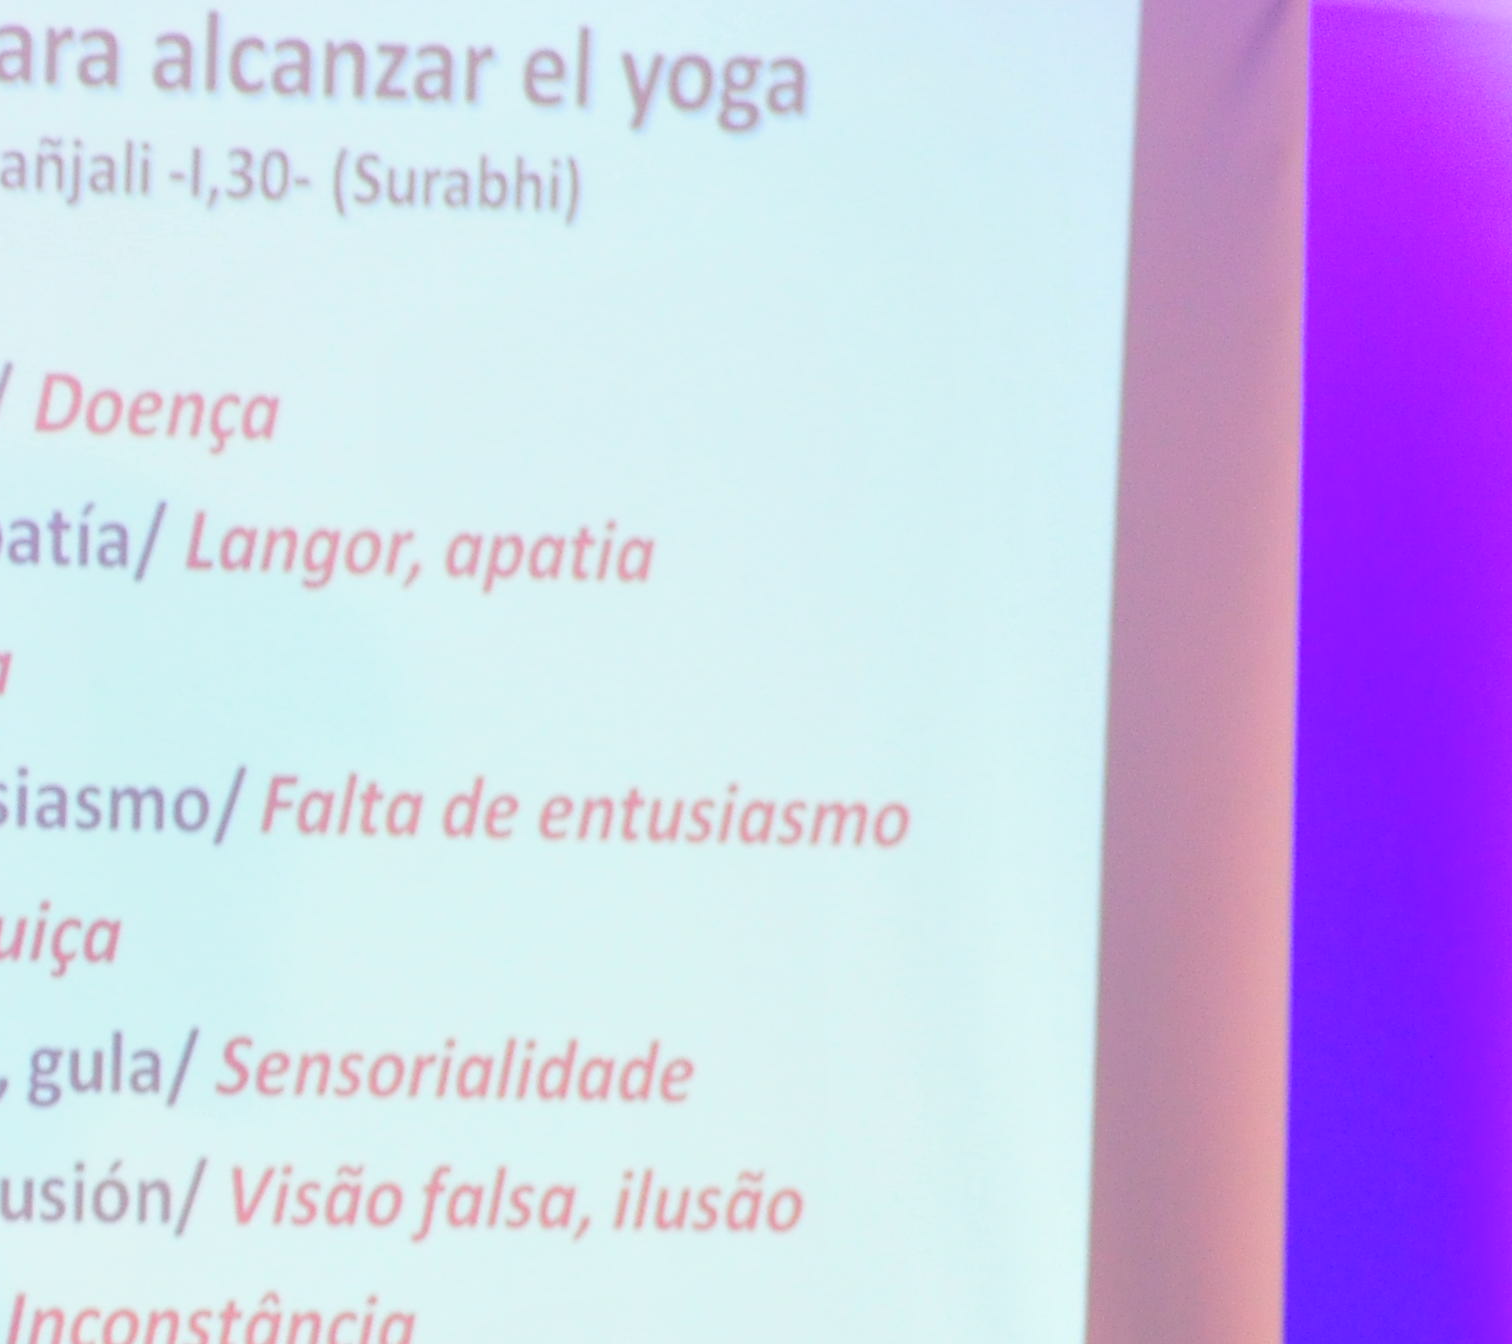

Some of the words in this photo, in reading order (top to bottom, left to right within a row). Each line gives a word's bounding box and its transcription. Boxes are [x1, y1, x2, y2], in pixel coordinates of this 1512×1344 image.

[152, 9, 497, 105] alcanzar
[523, 24, 593, 109] el
[621, 51, 809, 135] yoga
[333, 147, 582, 225] (Surabhi)
[34, 371, 281, 456] Doença
[185, 509, 422, 591] Langor,
[444, 519, 656, 594] apatia
[260, 771, 425, 838] Falta
[441, 775, 520, 841] de
[538, 782, 912, 849] entusiasmo
[214, 1034, 696, 1104] Sensorialidade
[231, 1164, 405, 1229] Visão
[410, 1163, 592, 1244] falsa,
[613, 1168, 805, 1234] ilusão
